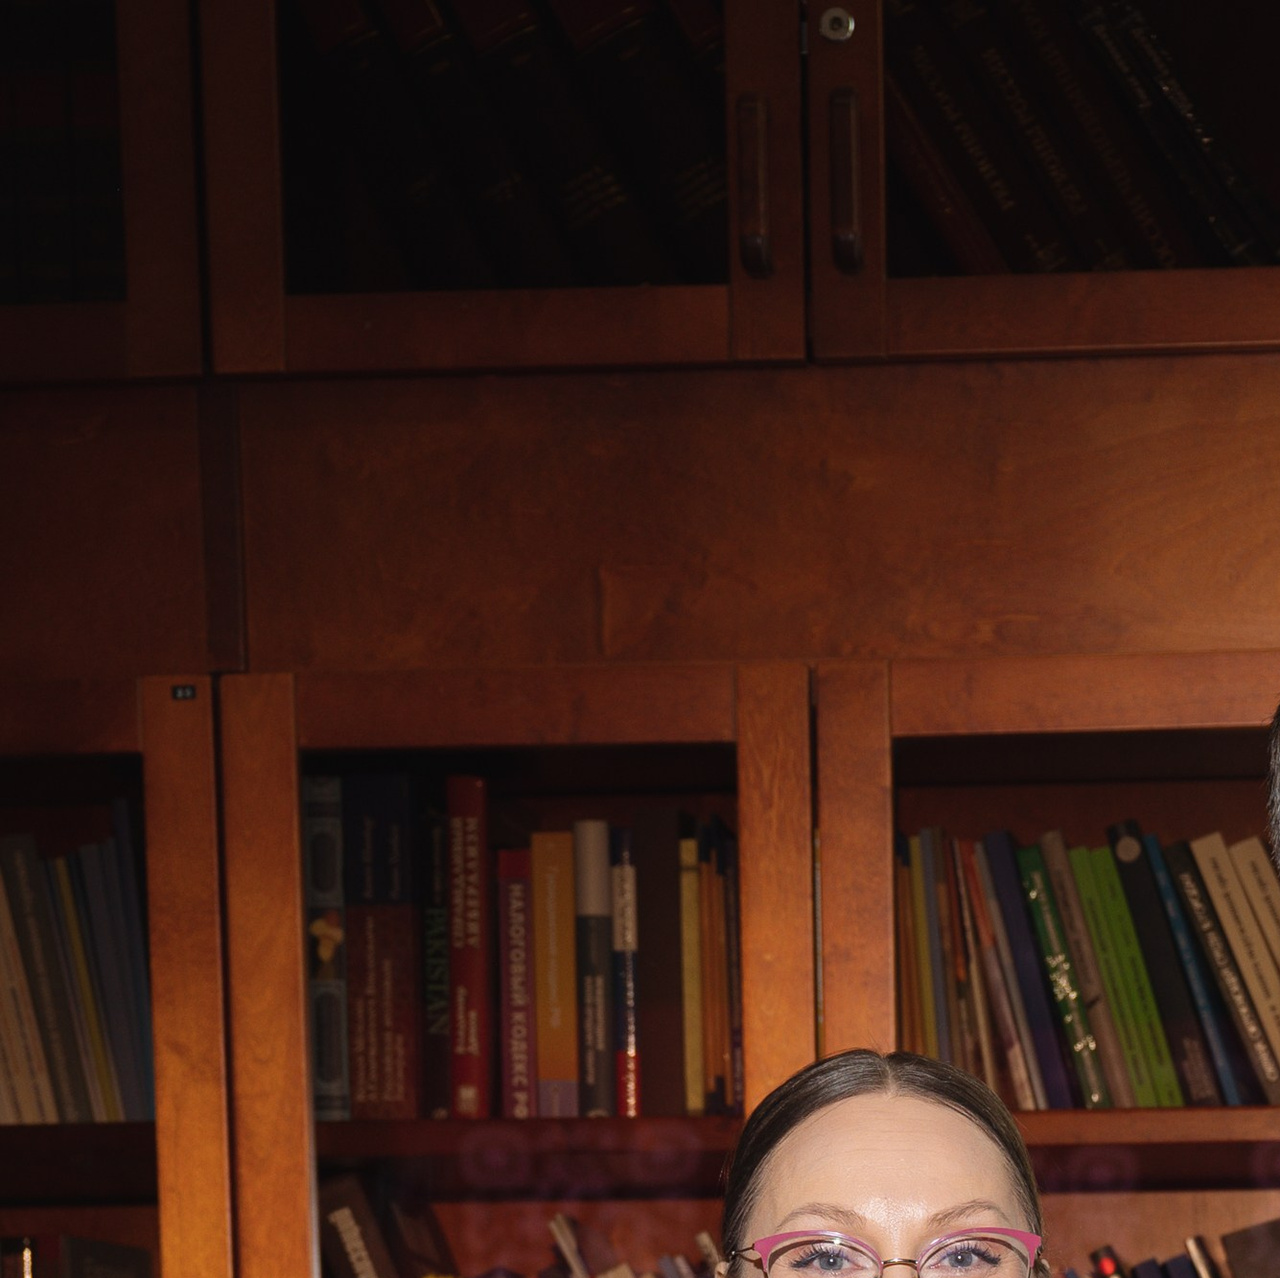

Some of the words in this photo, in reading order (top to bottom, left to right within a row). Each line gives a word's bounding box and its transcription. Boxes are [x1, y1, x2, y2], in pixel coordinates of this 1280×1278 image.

[425, 906, 450, 1035] PAKISTAN
[507, 882, 527, 1006] НАЛОГОВЫЙ
[509, 1011, 529, 1087] КОДЕКС
